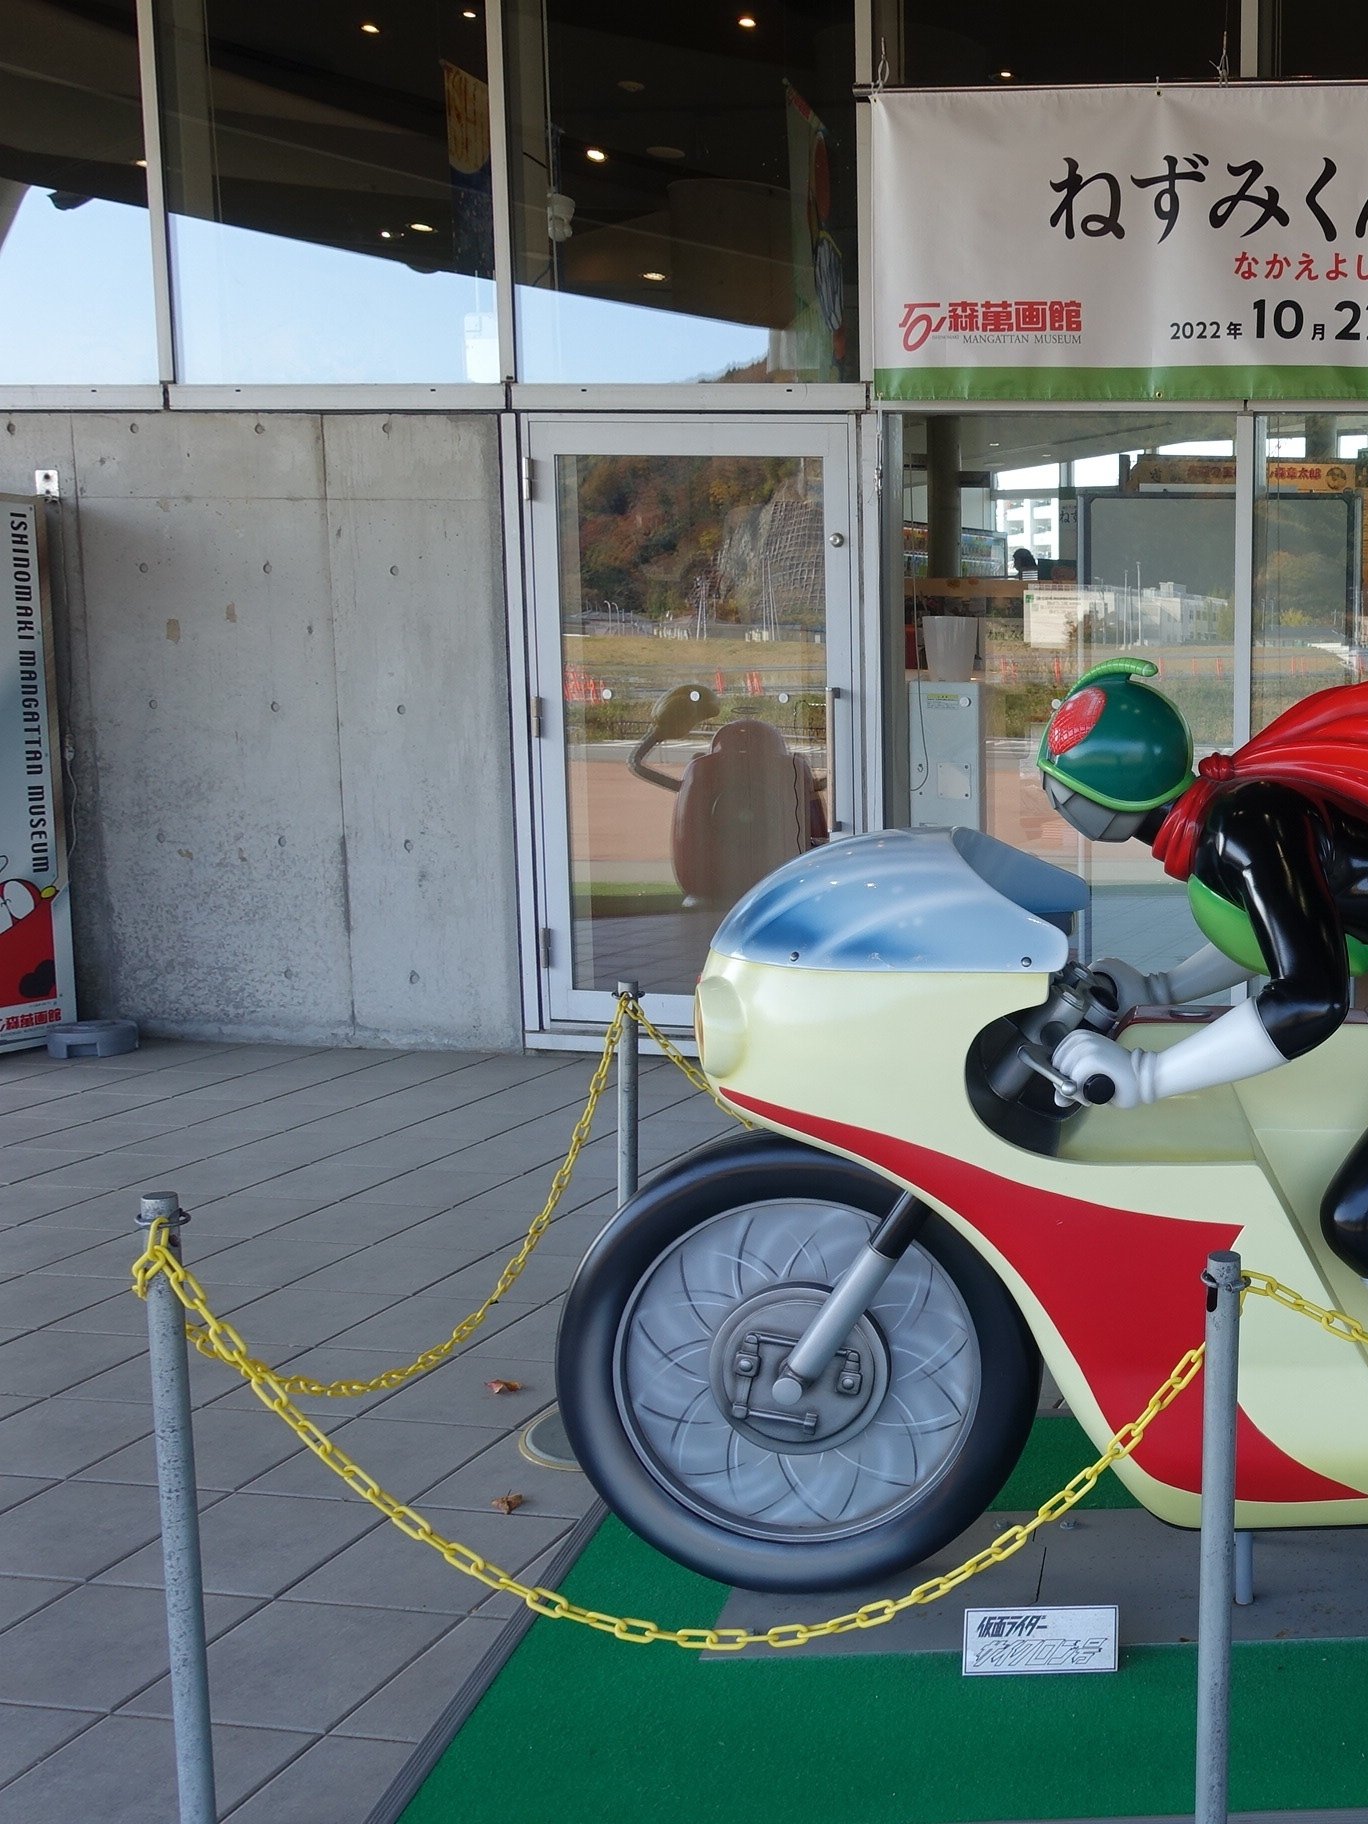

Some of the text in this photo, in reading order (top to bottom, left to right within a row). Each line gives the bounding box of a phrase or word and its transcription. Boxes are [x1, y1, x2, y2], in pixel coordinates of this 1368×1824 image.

[963, 334, 1029, 345] MANGATTAN
[1034, 334, 1082, 345] MUSEUM
[10, 511, 49, 874] ISHINOMAKI MANGATTAN MUSEUM
[977, 1614, 1048, 1638] 仮面ライダー
